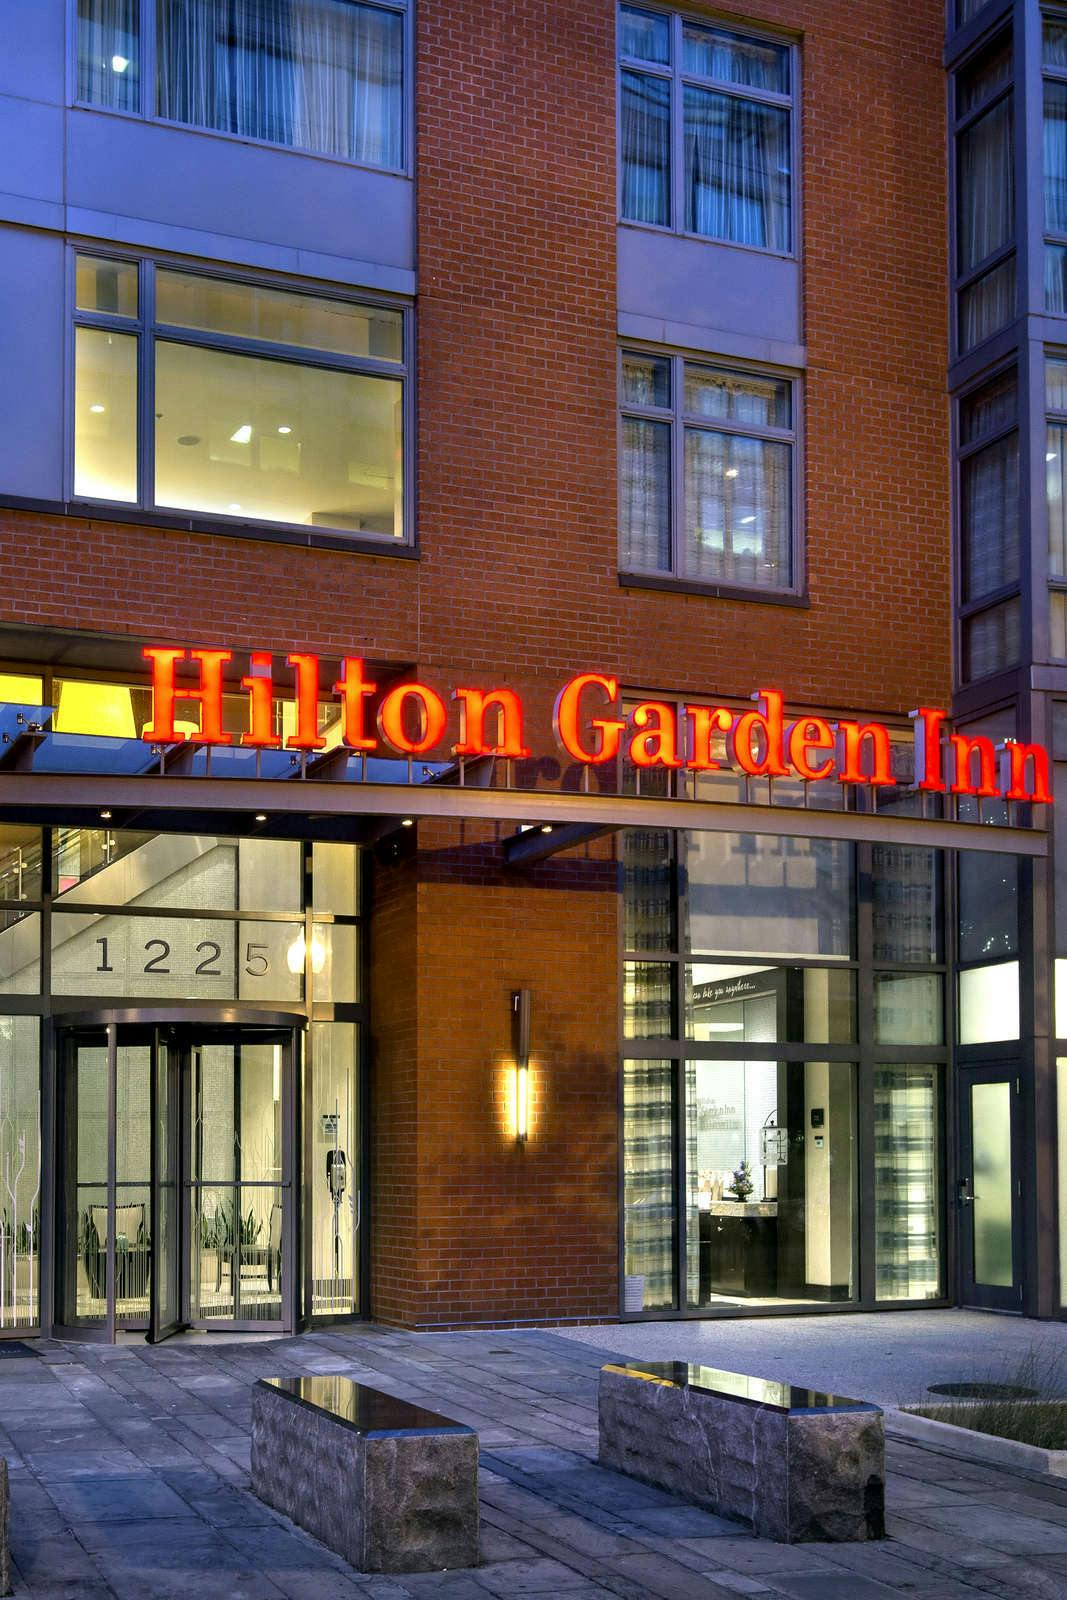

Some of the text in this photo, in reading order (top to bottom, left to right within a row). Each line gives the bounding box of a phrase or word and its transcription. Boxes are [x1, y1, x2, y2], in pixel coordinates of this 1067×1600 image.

[142, 647, 1054, 804] Hilton Garden Inn
[96, 937, 269, 976] 1225
